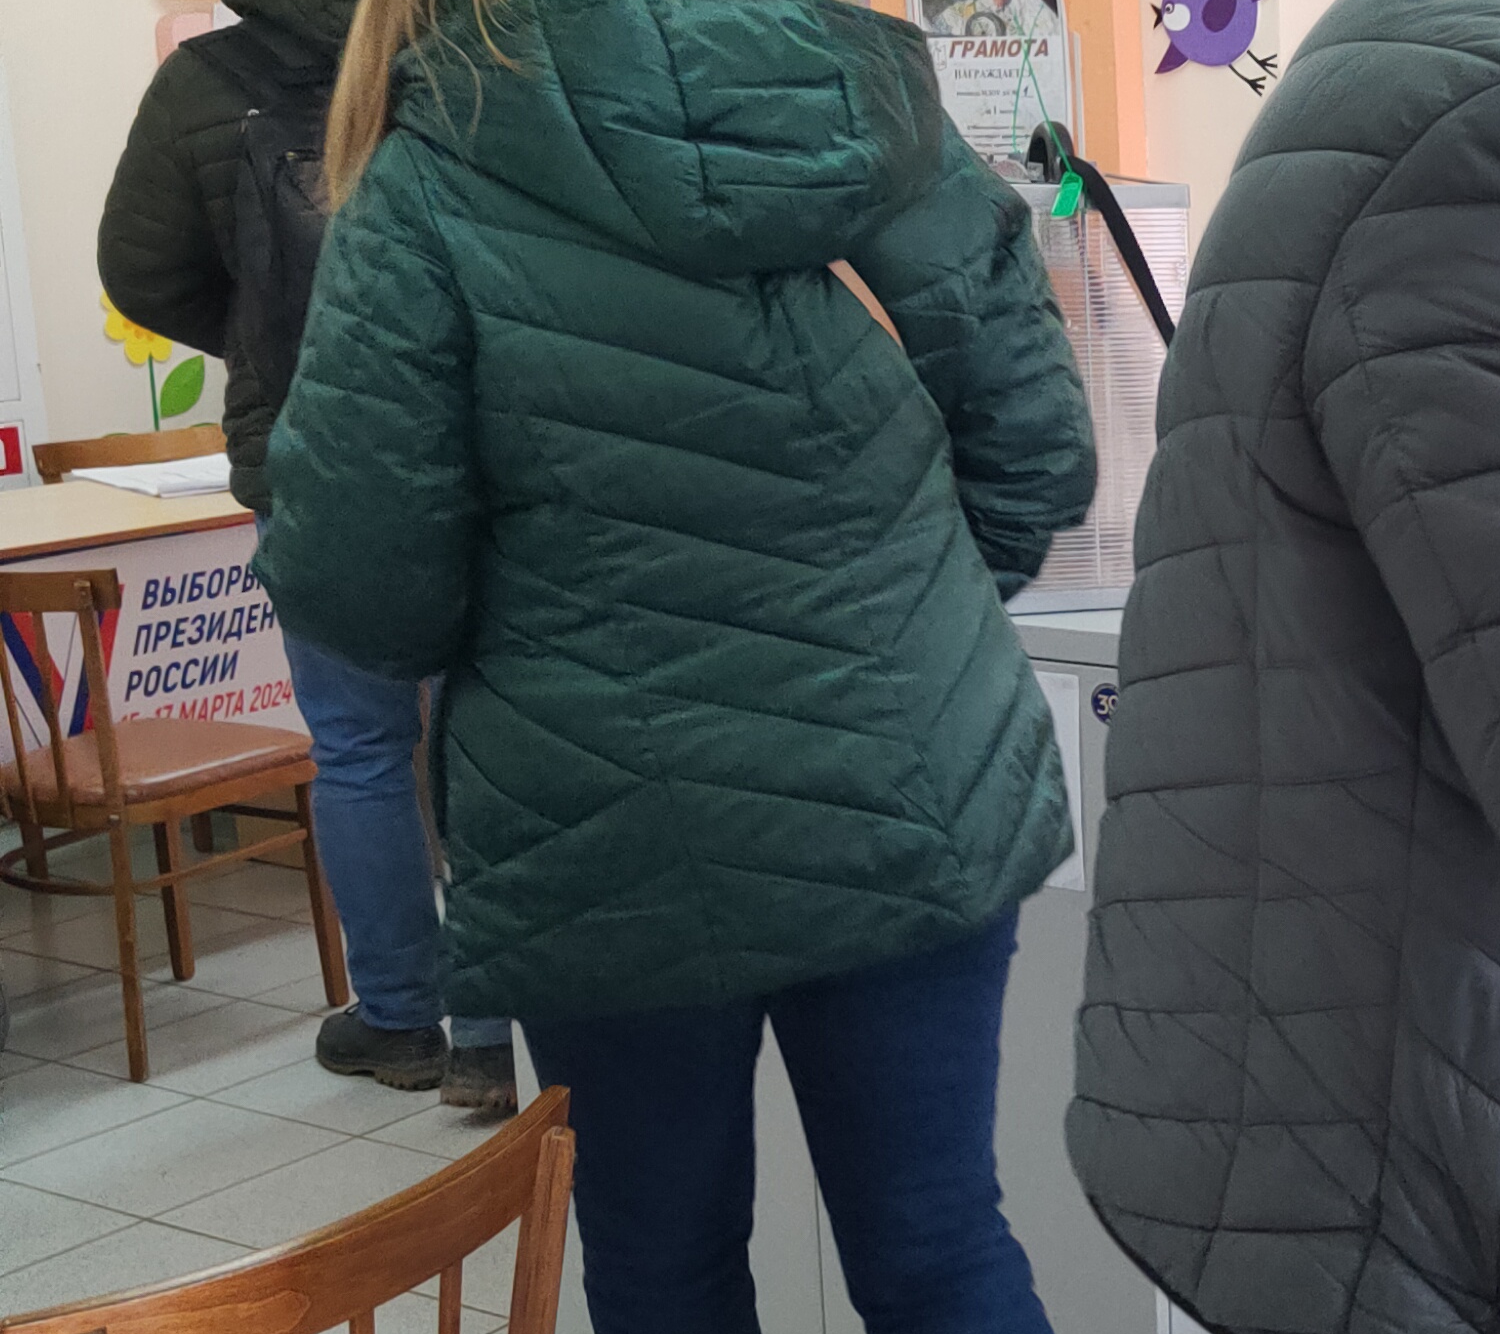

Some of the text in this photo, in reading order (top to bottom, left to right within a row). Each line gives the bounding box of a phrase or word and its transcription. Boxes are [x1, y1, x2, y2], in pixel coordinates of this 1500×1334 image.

[949, 38, 1049, 58] ГРАМОТА
[141, 563, 262, 612] ВЫБОРЫ
[133, 601, 276, 657] ПРЕЗИДЕН
[124, 649, 241, 703] РОССИИ
[178, 688, 244, 721] МАРТА
[249, 678, 293, 713] 2024
